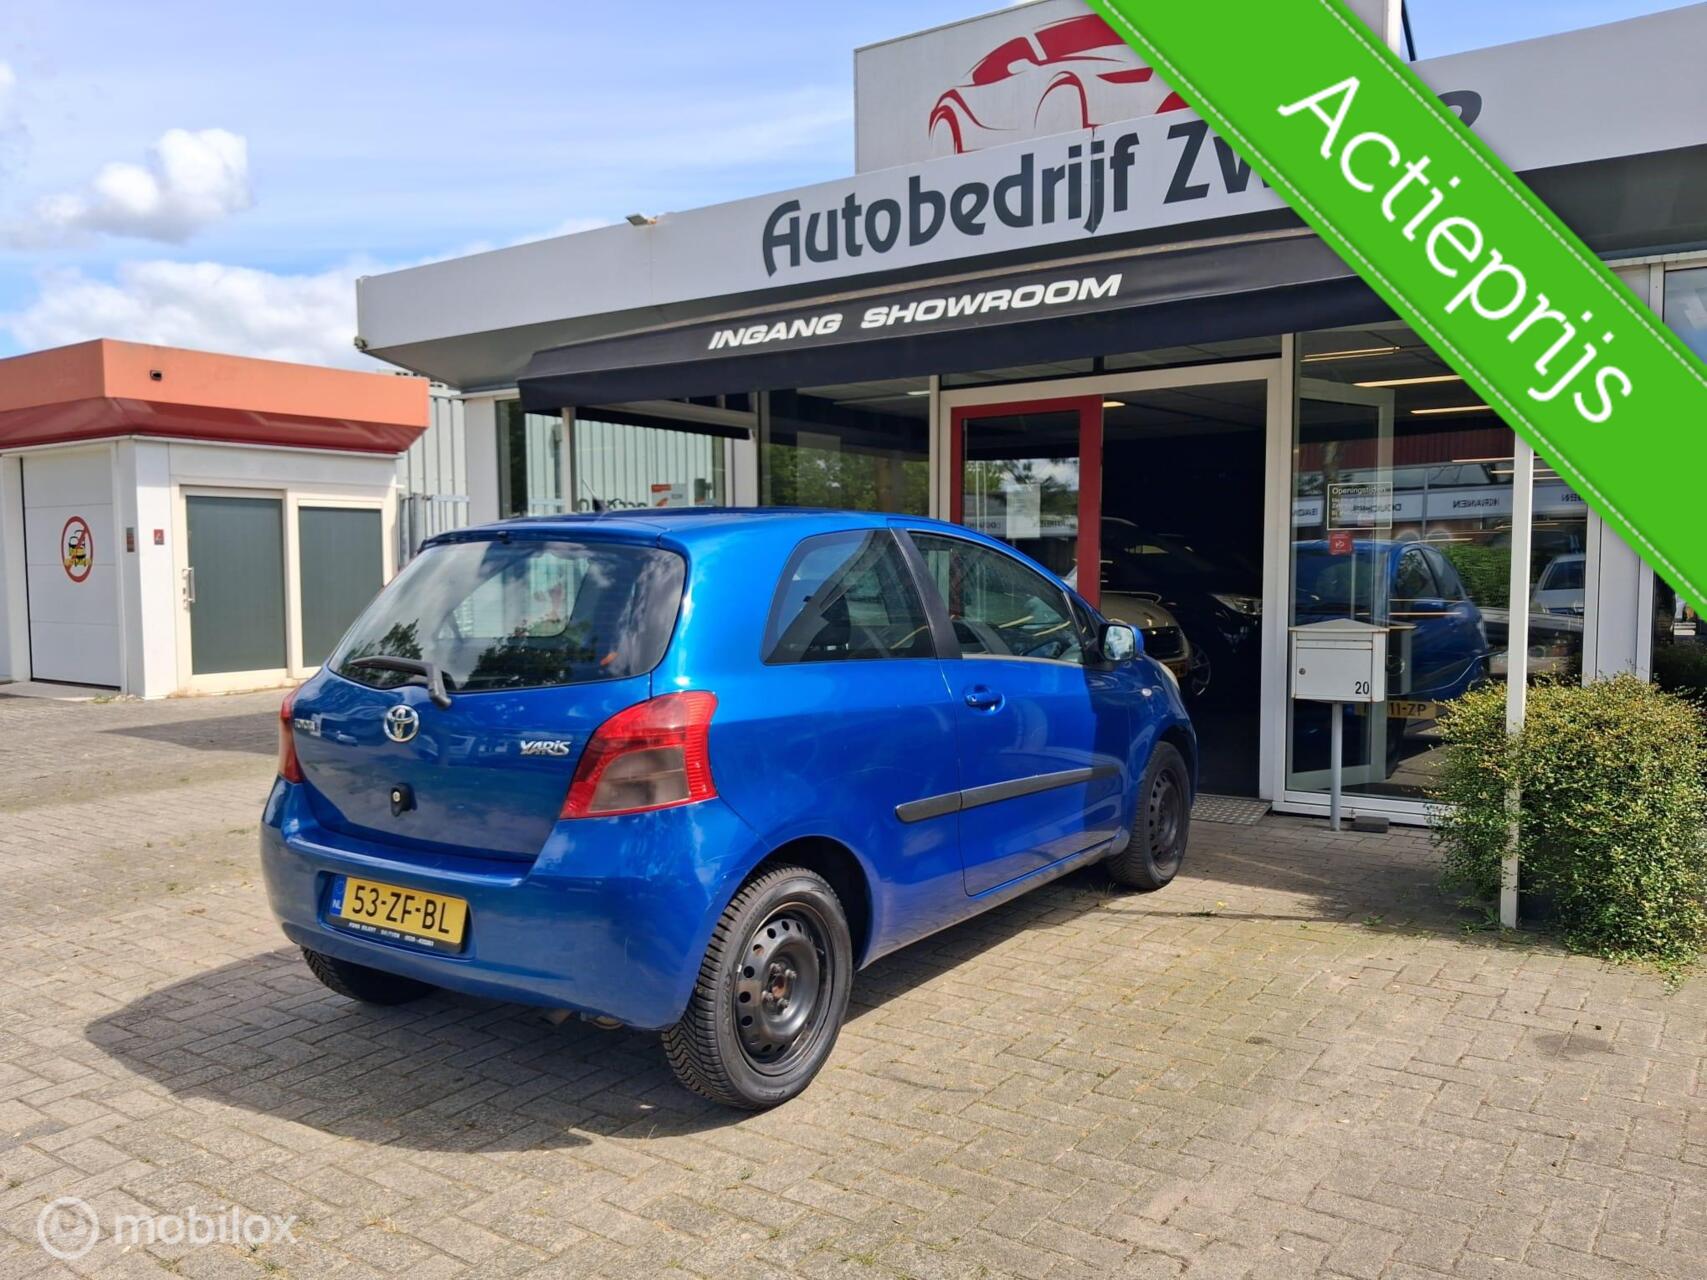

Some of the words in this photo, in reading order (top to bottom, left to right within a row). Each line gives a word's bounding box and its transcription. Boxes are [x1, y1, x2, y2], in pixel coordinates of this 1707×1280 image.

[762, 132, 1140, 277] Autobedrijf
[708, 314, 843, 350] INGANG
[861, 274, 1123, 329] SHOWROOM
[1355, 681, 1370, 694] 20
[332, 899, 343, 909] NL
[352, 885, 450, 934] 53-ZF-BL
